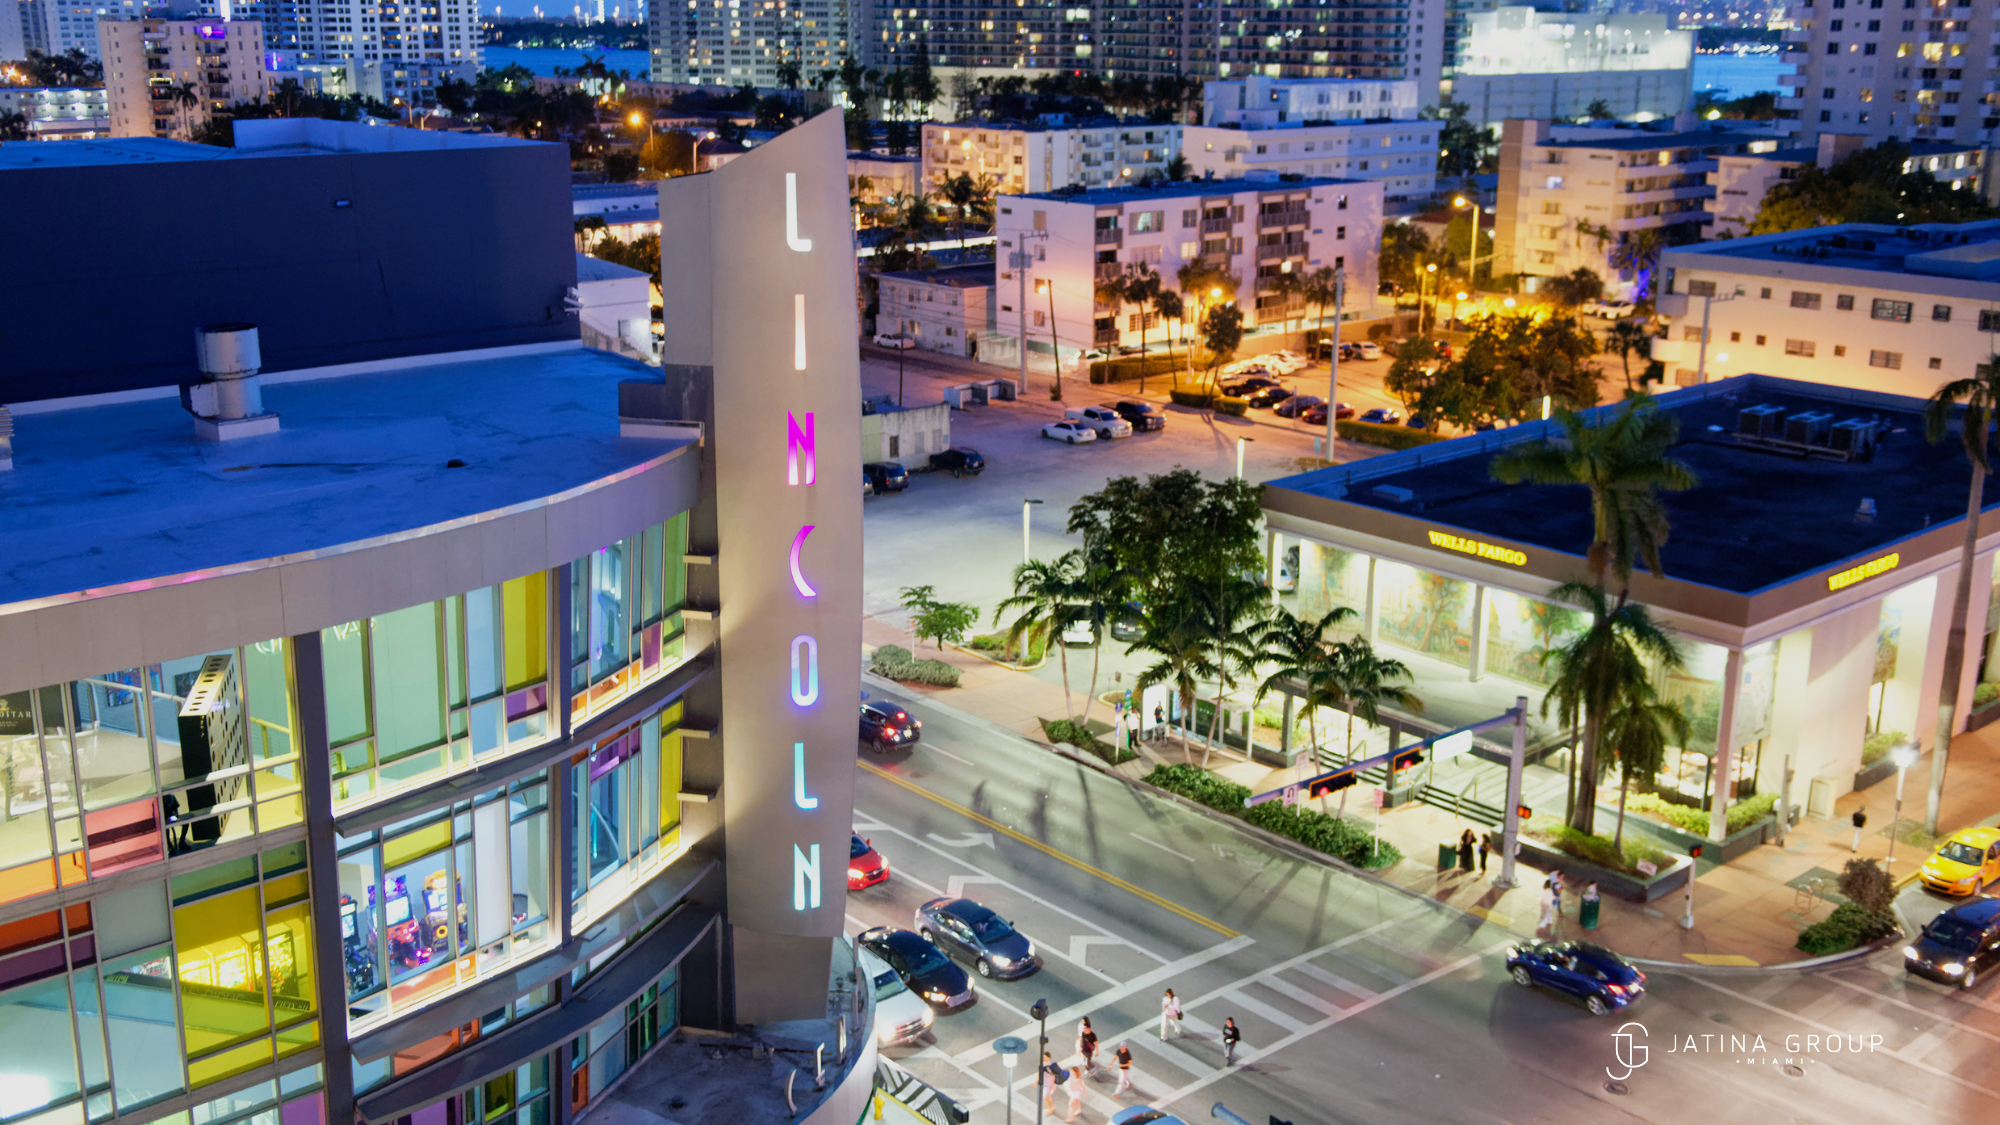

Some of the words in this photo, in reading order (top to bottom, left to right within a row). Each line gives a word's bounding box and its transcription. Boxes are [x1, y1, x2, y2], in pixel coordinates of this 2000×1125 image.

[786, 173, 819, 911] LINCOLN
[1428, 530, 1477, 554] WELLS
[1477, 542, 1527, 566] FARGO
[1828, 566, 1865, 591] WELLS
[1865, 552, 1899, 577] FARGO
